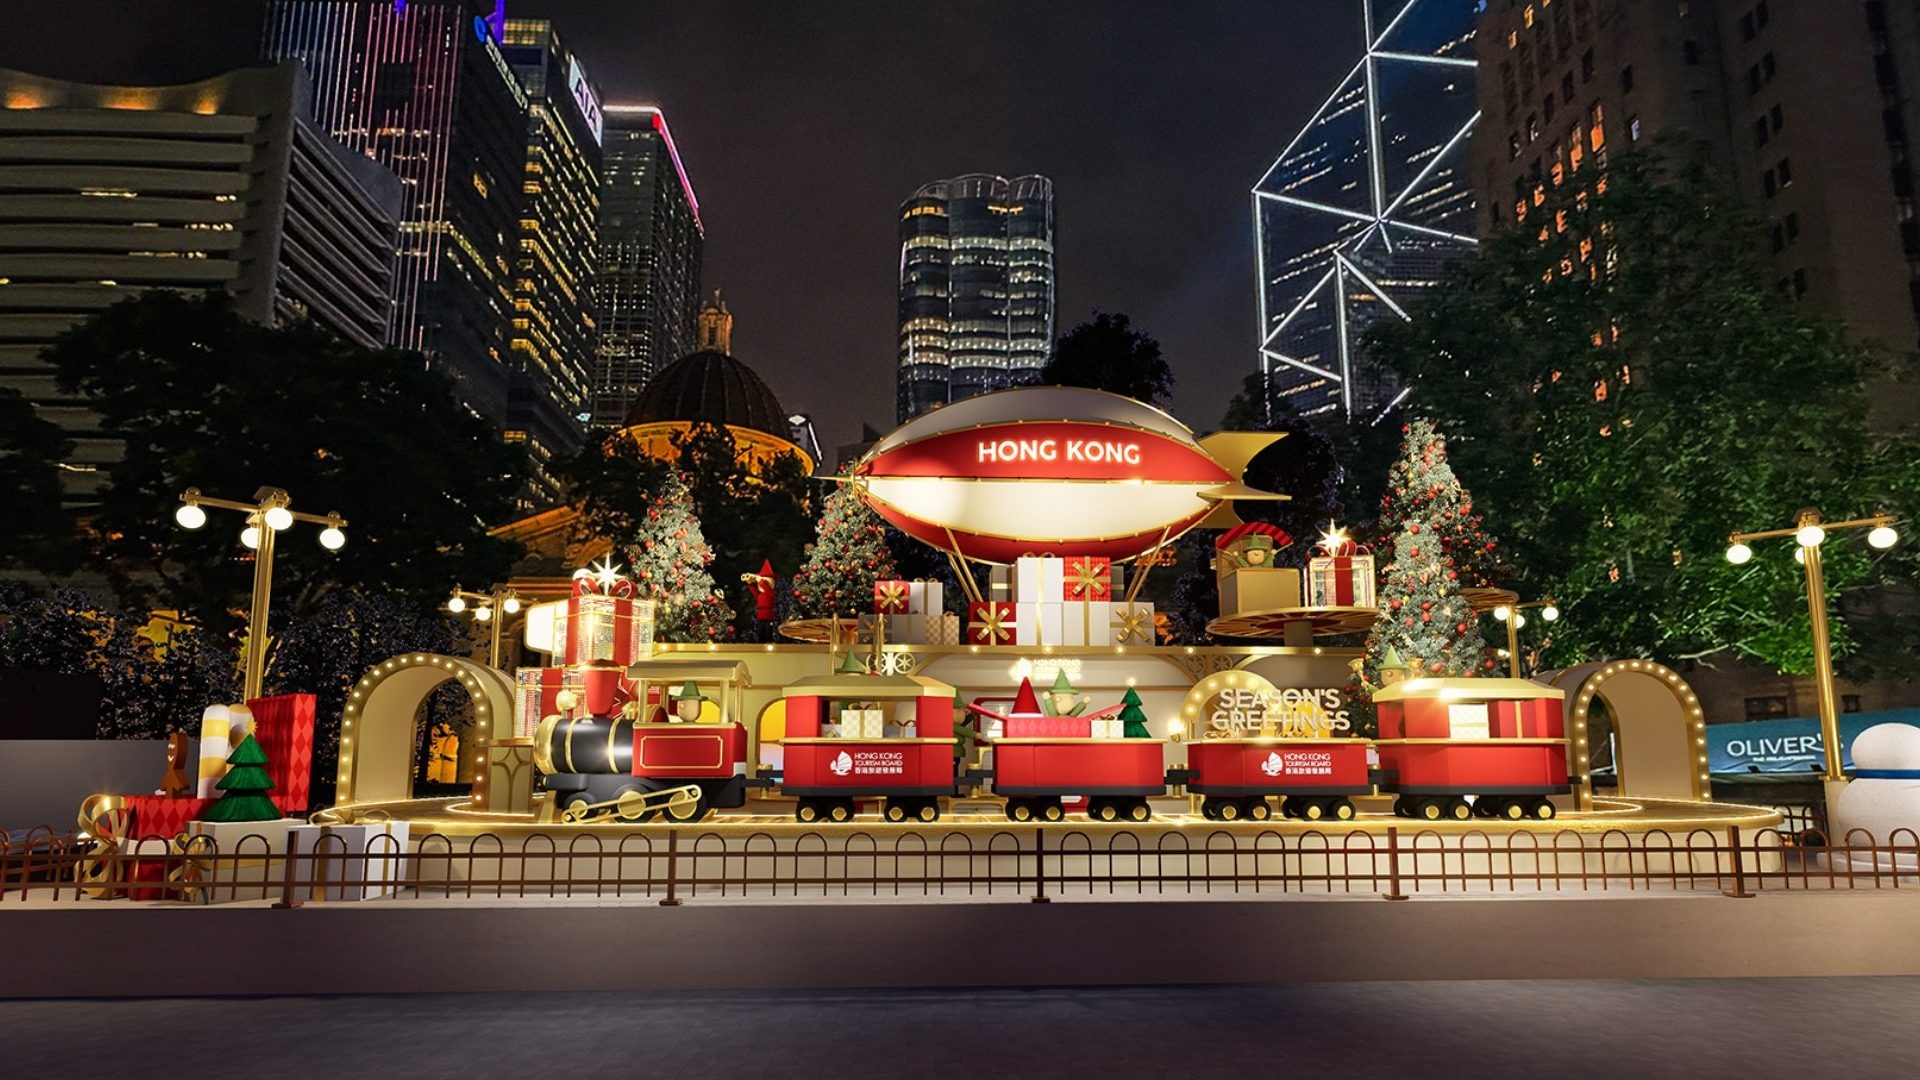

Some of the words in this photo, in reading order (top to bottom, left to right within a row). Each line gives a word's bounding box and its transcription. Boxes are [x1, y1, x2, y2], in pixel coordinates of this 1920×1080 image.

[575, 77, 598, 133] AIA
[978, 440, 1056, 463] HONG
[1067, 440, 1141, 464] KONG
[1219, 688, 1341, 709] SEASON'S
[1211, 710, 1351, 730] GREETINGS
[1727, 731, 1844, 757] OLIVER'
[854, 752, 878, 760] HONG
[879, 752, 903, 760] KONG
